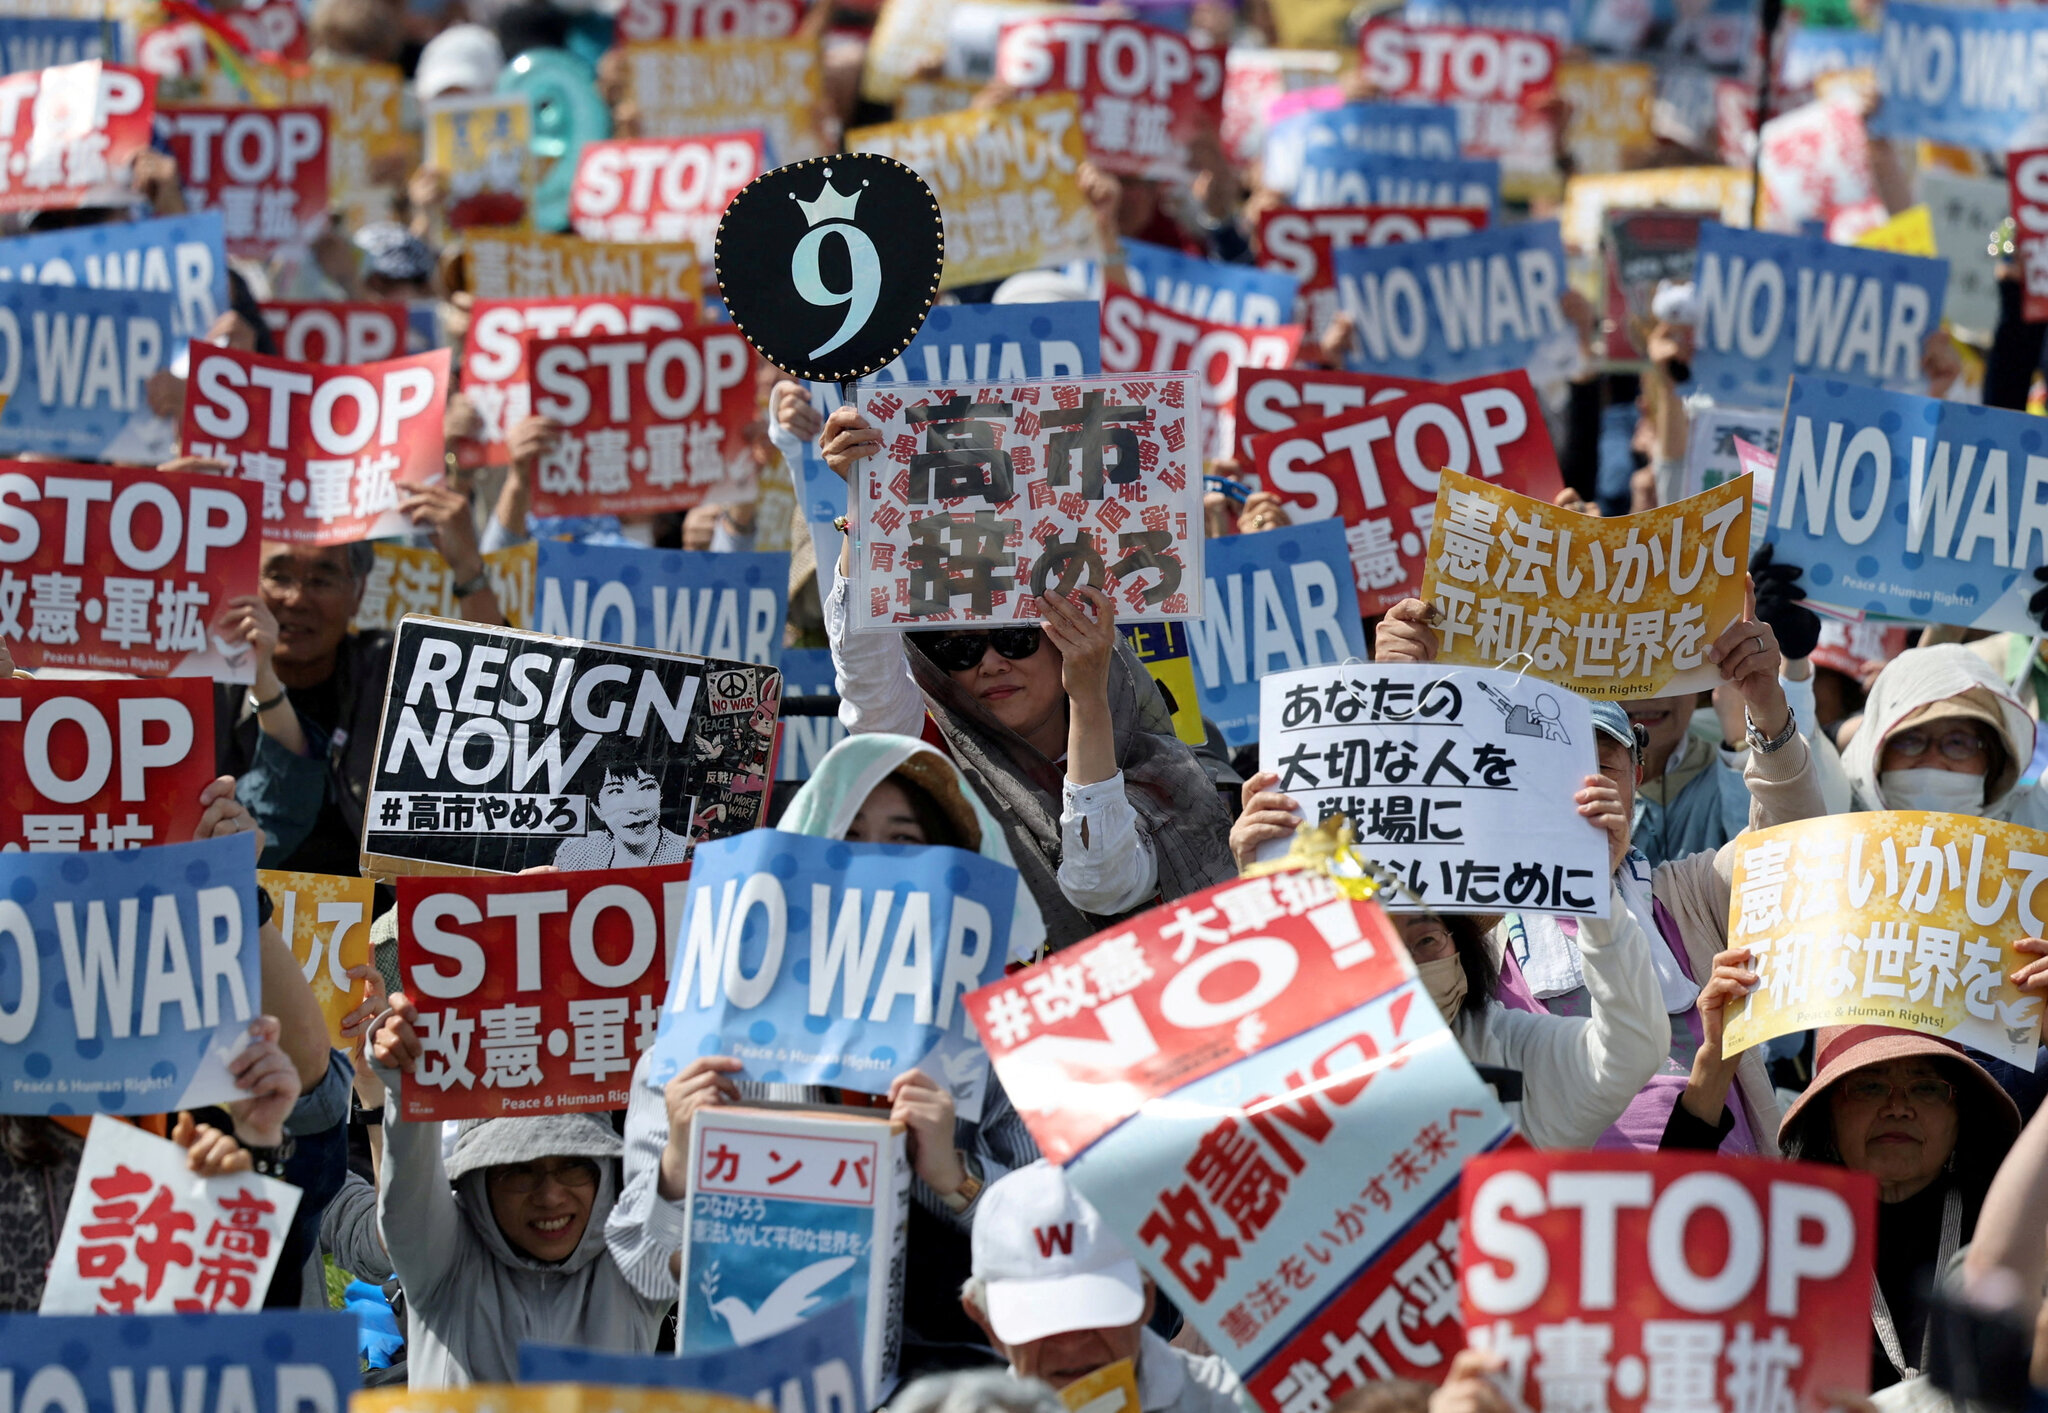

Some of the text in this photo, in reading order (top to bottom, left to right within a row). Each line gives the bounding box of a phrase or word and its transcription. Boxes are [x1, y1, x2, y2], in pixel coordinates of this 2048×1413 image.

[1002, 22, 1192, 98] STOP
[1364, 25, 1551, 99] STOP
[1882, 23, 1955, 107] NO
[575, 141, 758, 216] STOP
[792, 222, 882, 361] 9
[1339, 267, 1427, 361] NO
[1427, 248, 1567, 352] WAR
[1699, 252, 1785, 359] NO
[1794, 267, 1930, 381] WAR
[193, 356, 435, 456] STOP
[535, 334, 748, 426] STOP
[537, 422, 726, 497] 改憲・軍拡
[905, 392, 1147, 504] 高市
[1268, 388, 1528, 525] STOP
[1777, 415, 2048, 570] NO WAR
[0, 473, 248, 573] STOP
[908, 510, 1182, 618] 辞めろ
[1437, 487, 1744, 605] 憲法いかして
[541, 577, 778, 668] NO WAR
[1186, 559, 1351, 690] WAR
[1431, 581, 1707, 680] 平和な世界を
[1842, 575, 1975, 608] Peace & Human Rights!
[404, 637, 701, 743] RESIGN
[697, 715, 731, 733] PEACE
[711, 696, 756, 714] NO WAR
[1281, 677, 1463, 728] あなたの
[1608, 682, 1653, 696] Rights!
[0, 696, 194, 804] OP
[383, 704, 602, 795] NOW
[1278, 738, 1518, 792] 大切な人を
[379, 794, 578, 832] #高市やめろ
[719, 789, 759, 809] NO MORE
[728, 804, 756, 821] WAR!
[1735, 826, 2048, 939] 憲法いかして
[54, 885, 252, 1041] WAR
[671, 871, 992, 1042] NO WAR
[985, 871, 1340, 1048] #改憲 大軍拡
[993, 900, 1376, 1110] NO!
[1834, 1006, 1845, 1017] &
[1847, 1005, 1895, 1018] Human
[1898, 1008, 1945, 1028] Rights!
[13, 1074, 174, 1096] Peace & Human Rights!
[502, 1094, 540, 1110] Peace
[543, 1094, 554, 1107] &
[557, 1091, 605, 1108] Human
[1032, 1222, 1075, 1259] W
[1218, 1108, 1483, 1352] 憲法をいかす未来へ
[1466, 1170, 1856, 1318] STOP
